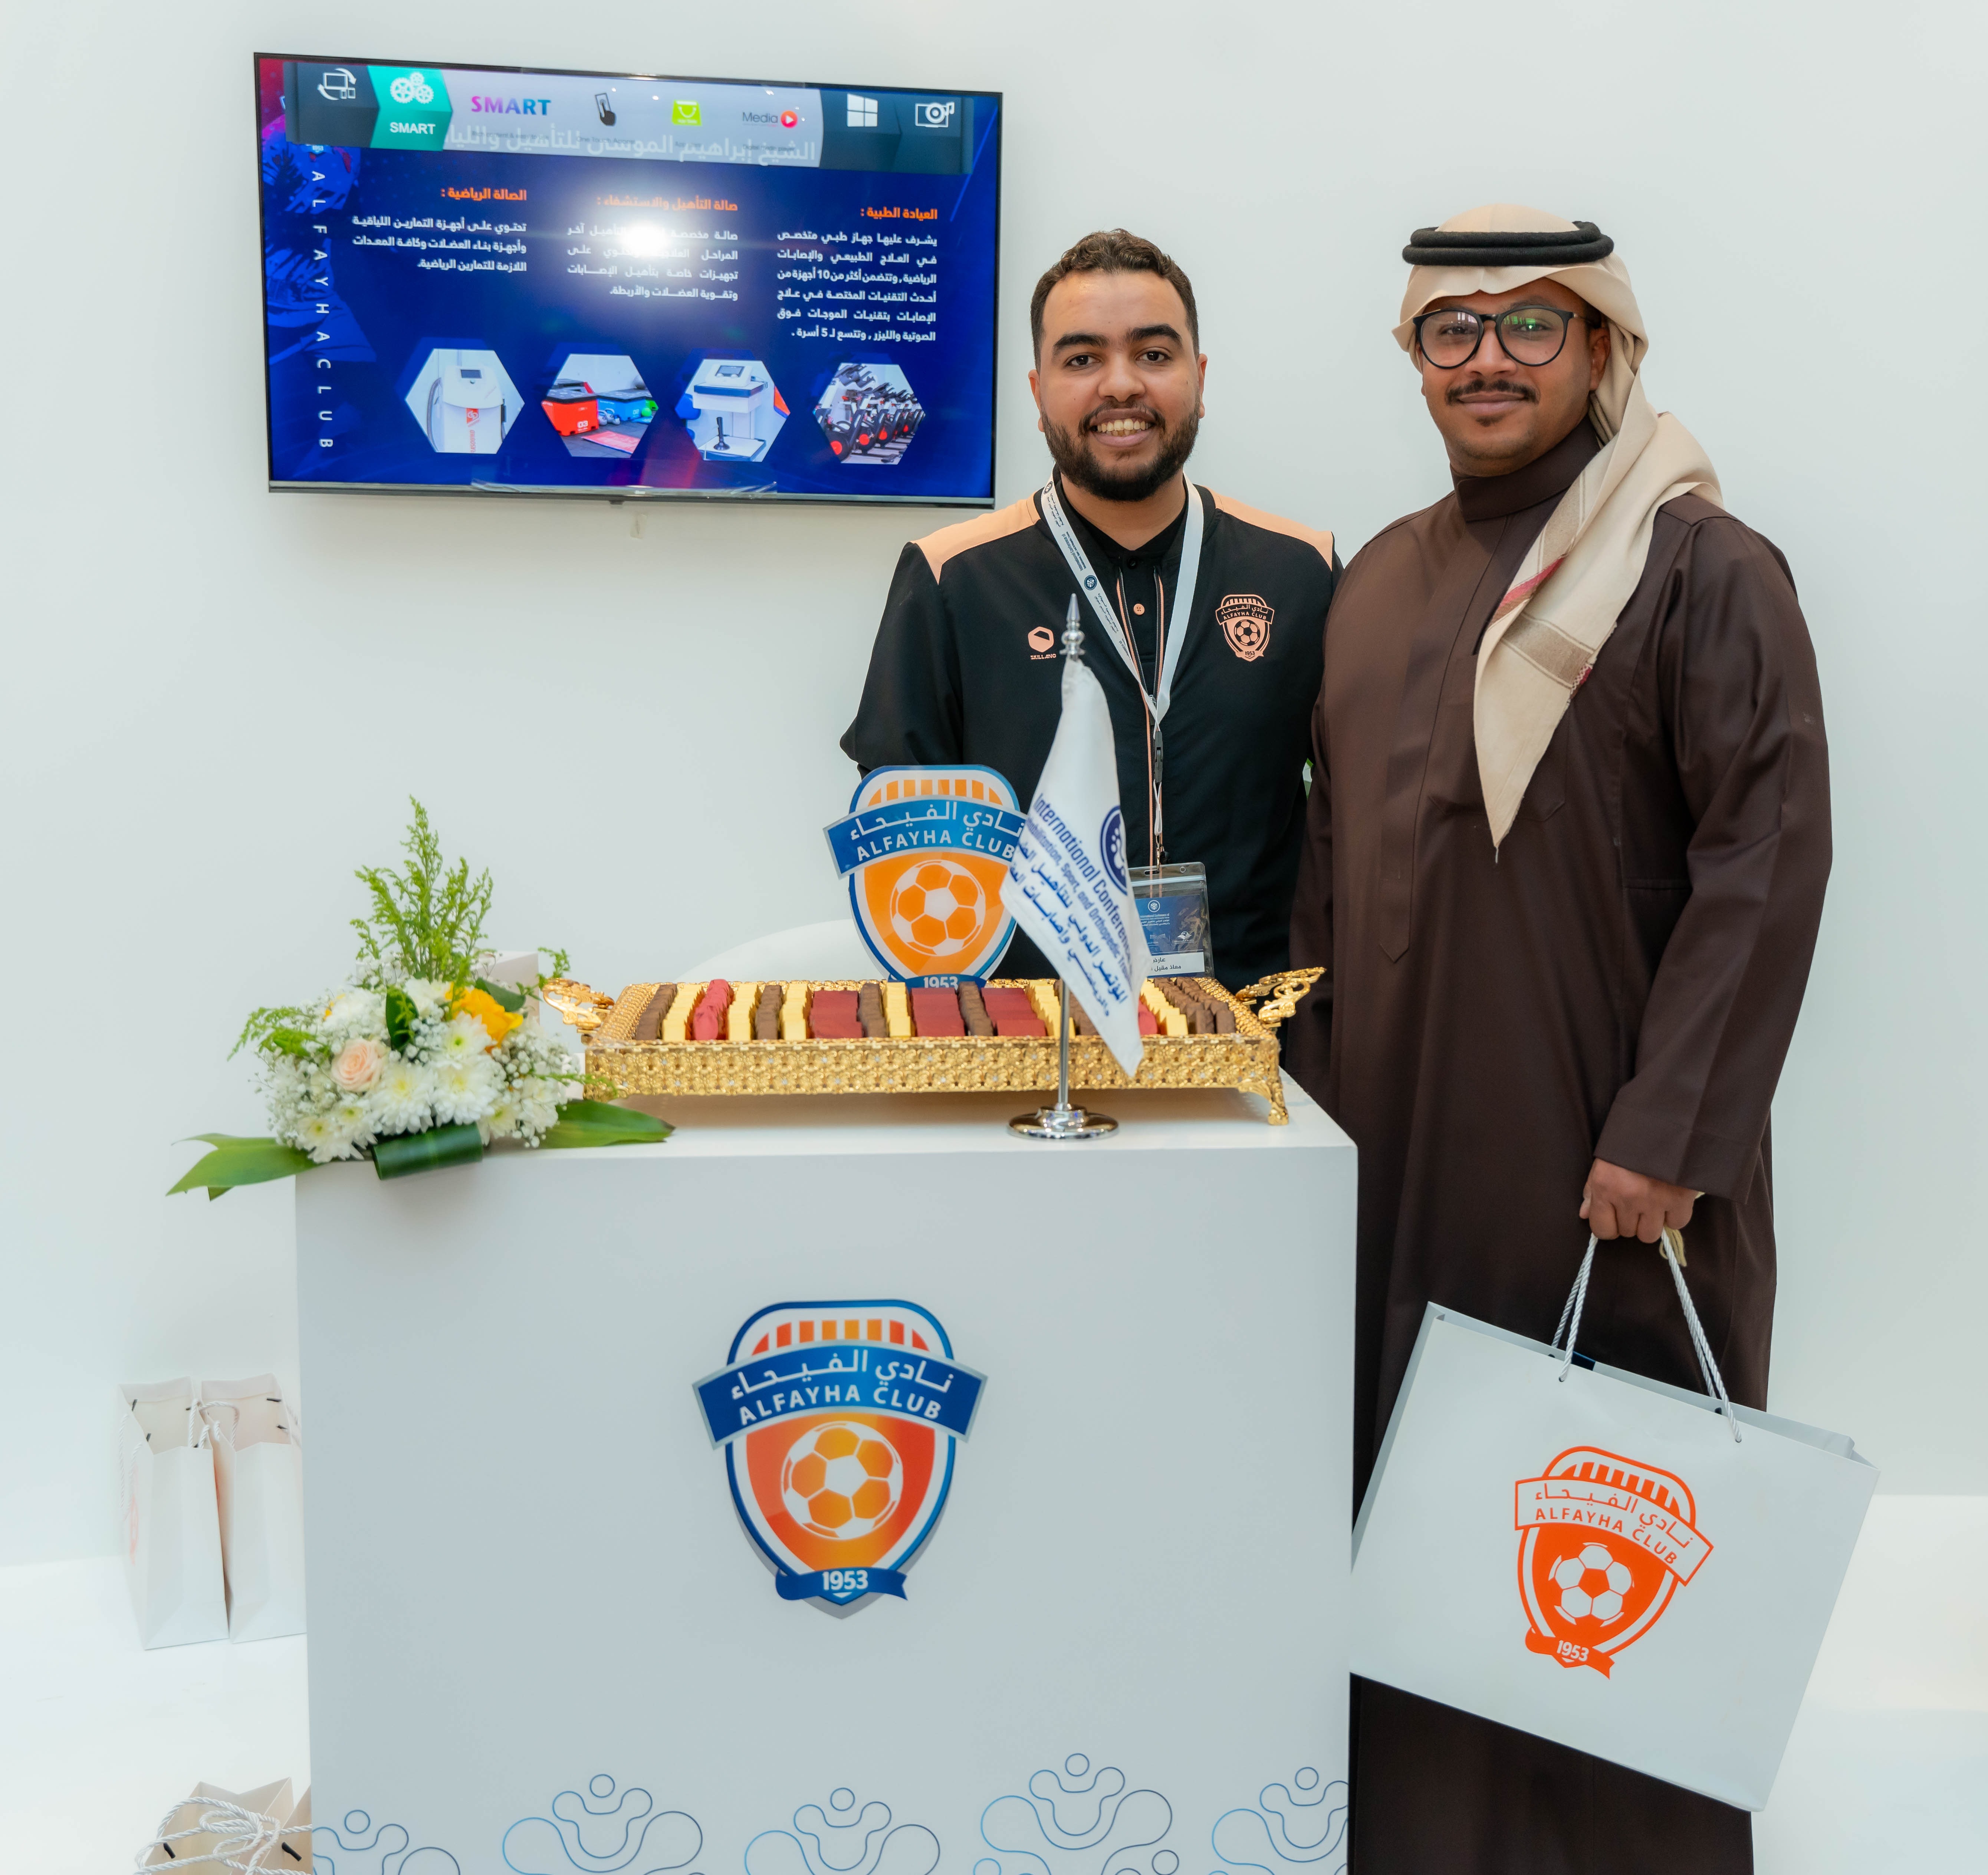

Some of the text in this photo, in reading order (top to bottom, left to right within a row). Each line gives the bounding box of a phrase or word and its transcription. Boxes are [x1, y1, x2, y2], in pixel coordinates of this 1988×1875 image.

[471, 96, 552, 116] SMART
[742, 112, 778, 124] Media
[390, 122, 436, 134] SMART
[447, 187, 491, 201] الرياضية
[493, 189, 527, 201] الصالة
[672, 195, 711, 211] التأهيل
[713, 200, 738, 211] صالة
[866, 206, 900, 219] الطبية
[903, 208, 938, 221] العيادة
[393, 217, 433, 229] التمارين
[436, 217, 464, 232] أجهزة
[467, 220, 492, 231] على
[494, 223, 526, 234] تحتوي
[567, 223, 585, 236] آخر
[714, 230, 738, 241] صالة
[777, 230, 937, 247] يشرف عليها جهاز طبي متخصص
[352, 235, 526, 254] وأجهزة بناء العضلات وكافة المعدات
[567, 244, 591, 256] على
[701, 249, 738, 261] المراحل
[777, 249, 937, 267] في العلاج الطبيعي والإصابات
[458, 259, 495, 271] للتمارين
[496, 261, 527, 273] اللازمة
[567, 264, 738, 282] تجهيزات خاصة بتأهيل الإصابات
[777, 270, 792, 280] من
[792, 267, 816, 282] أجهزة
[817, 270, 830, 279] 10
[830, 271, 844, 282] من
[845, 268, 861, 282] أكثر
[862, 273, 898, 284] وتتضمن
[652, 287, 698, 298] العضلات
[700, 290, 738, 301] وتقوية
[777, 288, 936, 303] أحدث التقنيات المختصة في علاج
[777, 308, 936, 324] الإصابات بتقنيات الموجات فوق
[796, 325, 819, 338] أسرة
[821, 328, 828, 337] 5
[837, 330, 866, 341] وتتسع
[873, 330, 901, 342] والليزر
[903, 330, 936, 342] الصوتية
[1221, 604, 1250, 615] الفيحاء
[1223, 611, 1249, 620] ALFAYHA
[850, 801, 1025, 840] نادي الفيحاء
[1033, 793, 1101, 882] International
[857, 829, 1016, 862] ALFAYHA CLUB
[1031, 862, 1072, 908] للتأهيل
[1023, 884, 1070, 944] وإصابات
[1061, 863, 1080, 893] Sport,
[1077, 891, 1095, 910] and
[1089, 908, 1120, 959] Orthopedic
[1068, 914, 1101, 957] الدولي
[924, 976, 958, 990] 1953
[1093, 961, 1128, 1004] المؤتمر
[731, 1349, 954, 1399] نادي الفيحاء
[740, 1384, 942, 1425] ALFAYHA CLUB
[1535, 1483, 1694, 1548] نادي الفيحاء
[1535, 1507, 1678, 1565] ALFAYHA CLUB
[822, 1569, 868, 1591] 1953
[1557, 1640, 1590, 1662] 1953
